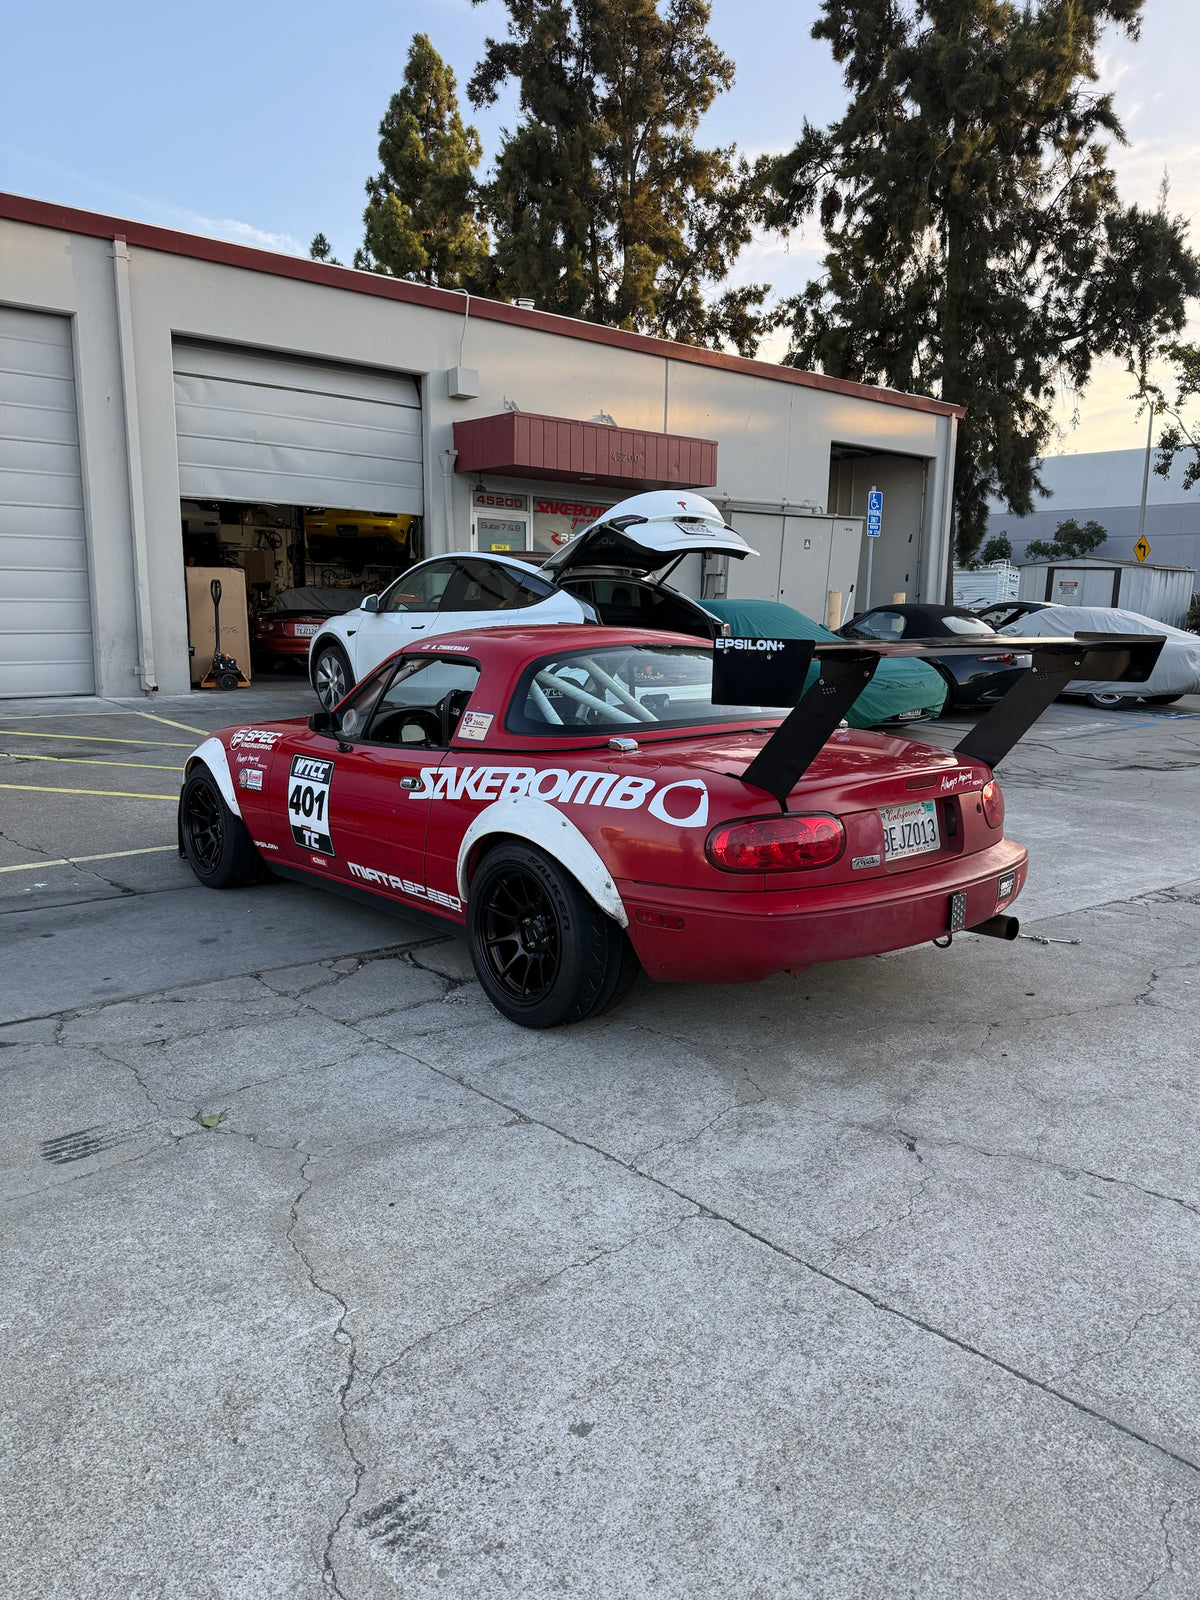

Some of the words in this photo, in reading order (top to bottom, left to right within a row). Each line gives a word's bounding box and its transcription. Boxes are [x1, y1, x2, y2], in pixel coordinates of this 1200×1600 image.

[476, 495, 523, 508] 45200
[534, 500, 608, 518] SAKEBOM
[715, 638, 785, 651] EPSILON+
[244, 730, 283, 744] SPEC
[408, 766, 656, 810] SAKEBOMB
[289, 784, 326, 821] 401
[886, 807, 926, 822] California
[302, 829, 320, 849] TC
[527, 855, 572, 931] FALKEN
